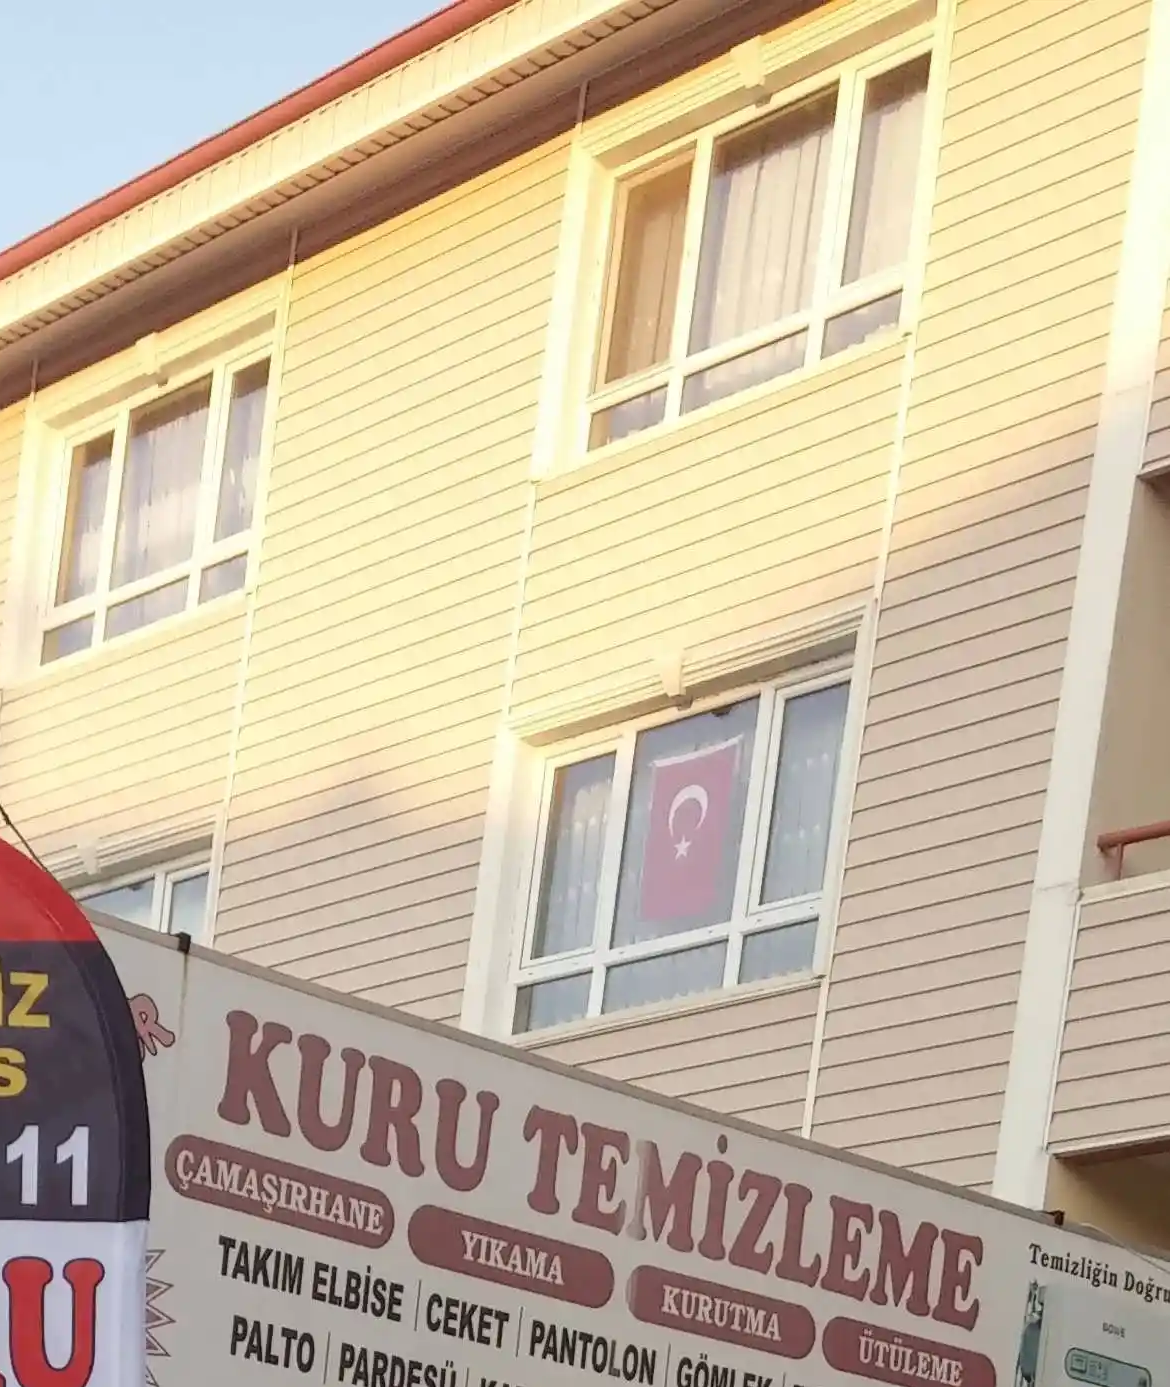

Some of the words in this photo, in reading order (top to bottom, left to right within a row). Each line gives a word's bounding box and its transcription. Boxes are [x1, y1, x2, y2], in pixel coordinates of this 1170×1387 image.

[6, 1124, 89, 1206] 11
[176, 1149, 385, 1236] ÇAMAŞIRHANE
[216, 1009, 499, 1192] KURU
[523, 1105, 984, 1332] TEMİZLEME
[460, 1230, 566, 1286] YIKAMA
[1029, 1243, 1118, 1288] Temizliğin
[218, 1234, 304, 1295] TAKIM
[312, 1263, 405, 1324] ELBİSE
[426, 1292, 510, 1350] CEKET
[530, 1318, 657, 1386] PANTOLON
[661, 1284, 782, 1342] KURUTMA
[230, 1316, 316, 1373] PALTO
[857, 1328, 964, 1387] ÜTÜLEME
